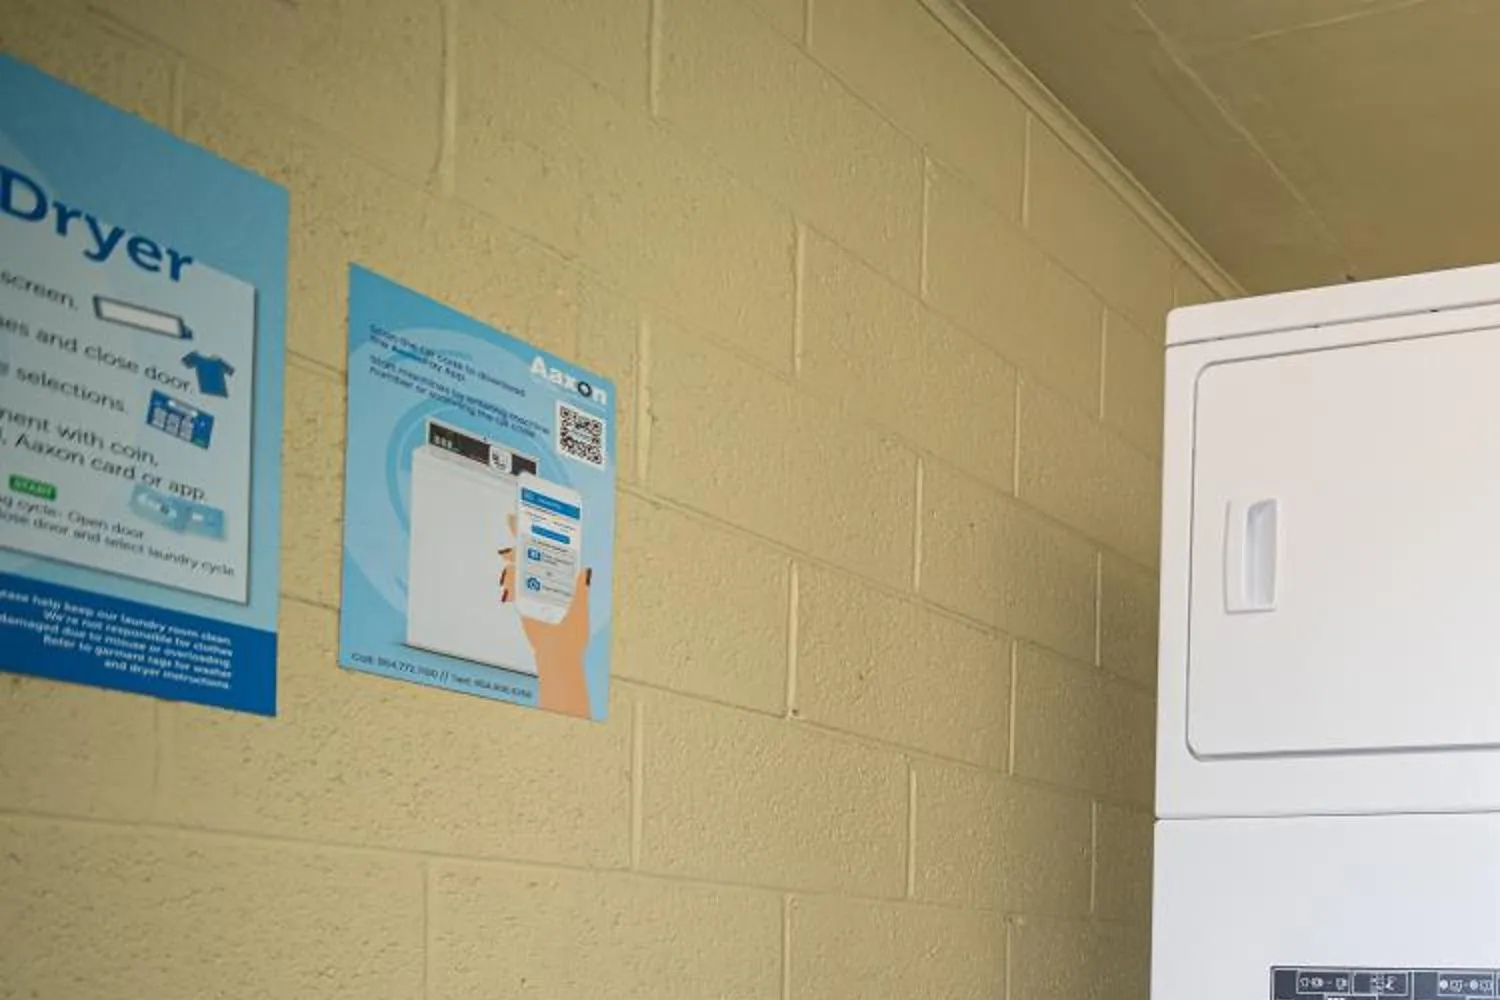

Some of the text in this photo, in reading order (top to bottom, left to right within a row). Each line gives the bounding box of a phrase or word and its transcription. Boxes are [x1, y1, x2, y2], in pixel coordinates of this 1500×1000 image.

[0, 164, 195, 283] Dryer
[36, 327, 79, 357] and
[85, 340, 142, 380] close
[531, 356, 608, 406] Aaxon
[14, 432, 86, 467] Aaxon
[90, 457, 135, 482] card
[58, 422, 104, 450] with
[110, 441, 160, 467] coin,
